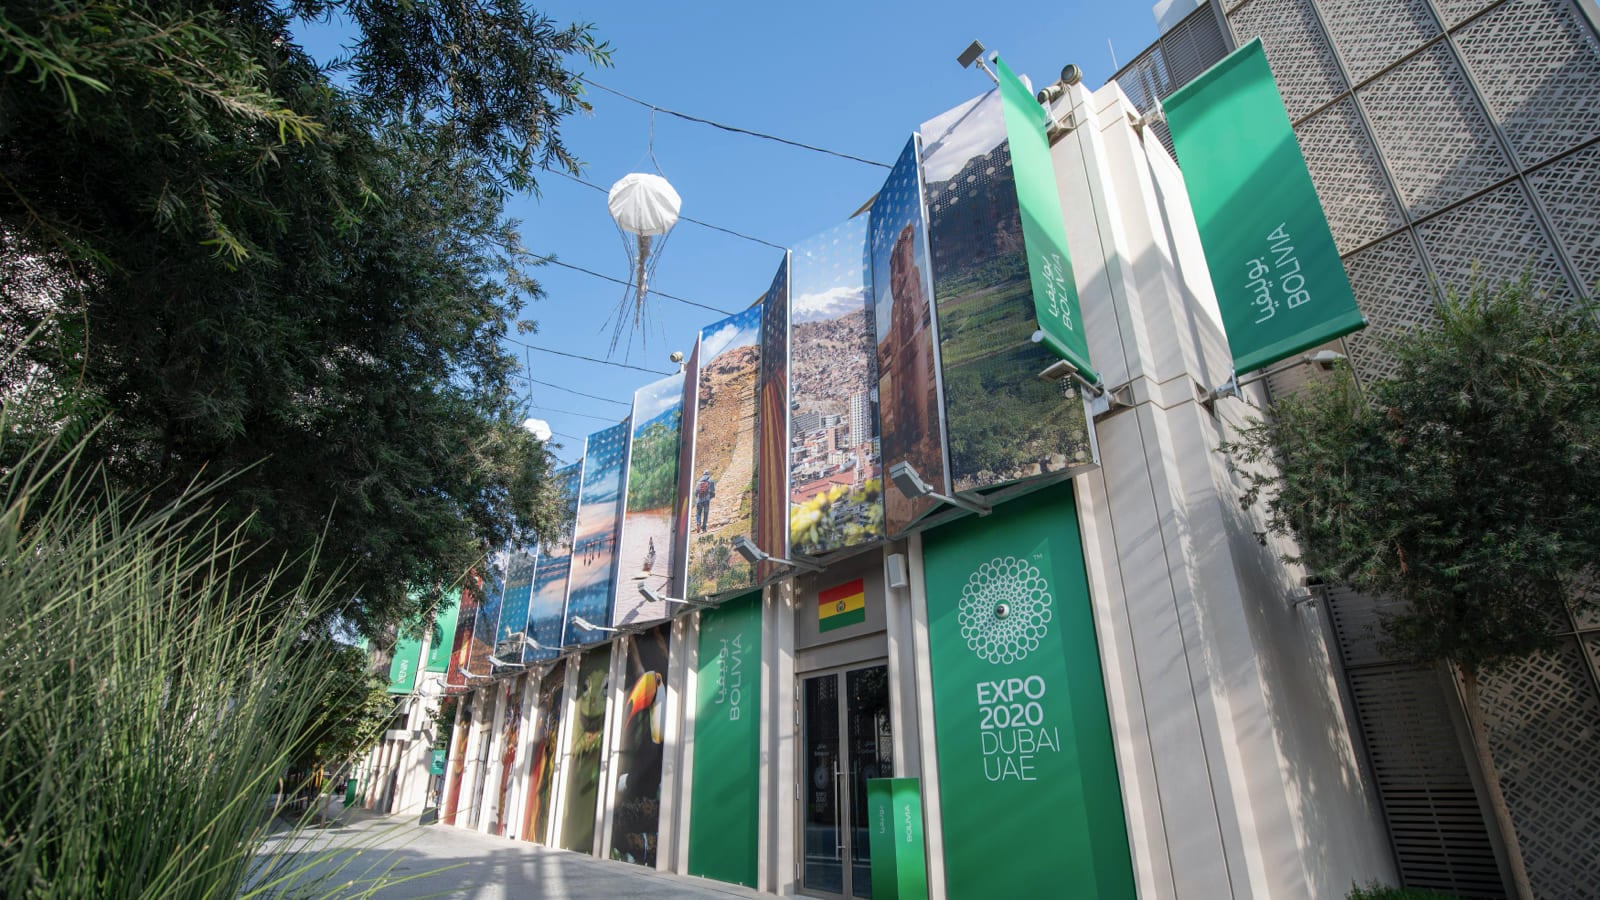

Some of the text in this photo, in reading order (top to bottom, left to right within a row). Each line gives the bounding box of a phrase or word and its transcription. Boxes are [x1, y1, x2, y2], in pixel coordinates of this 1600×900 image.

[1051, 253, 1073, 331] BOLIVIA
[1244, 256, 1280, 325] بوليفيا
[1266, 222, 1311, 310] BOLIVIA
[715, 638, 729, 704] بوليفيا
[729, 633, 742, 721] BOLIVIA
[976, 675, 1046, 706] EXPO
[979, 701, 1044, 730] 2020
[981, 726, 1060, 755] DUBAI
[983, 755, 1038, 782] UAE
[904, 804, 913, 842] BOLIVIA
